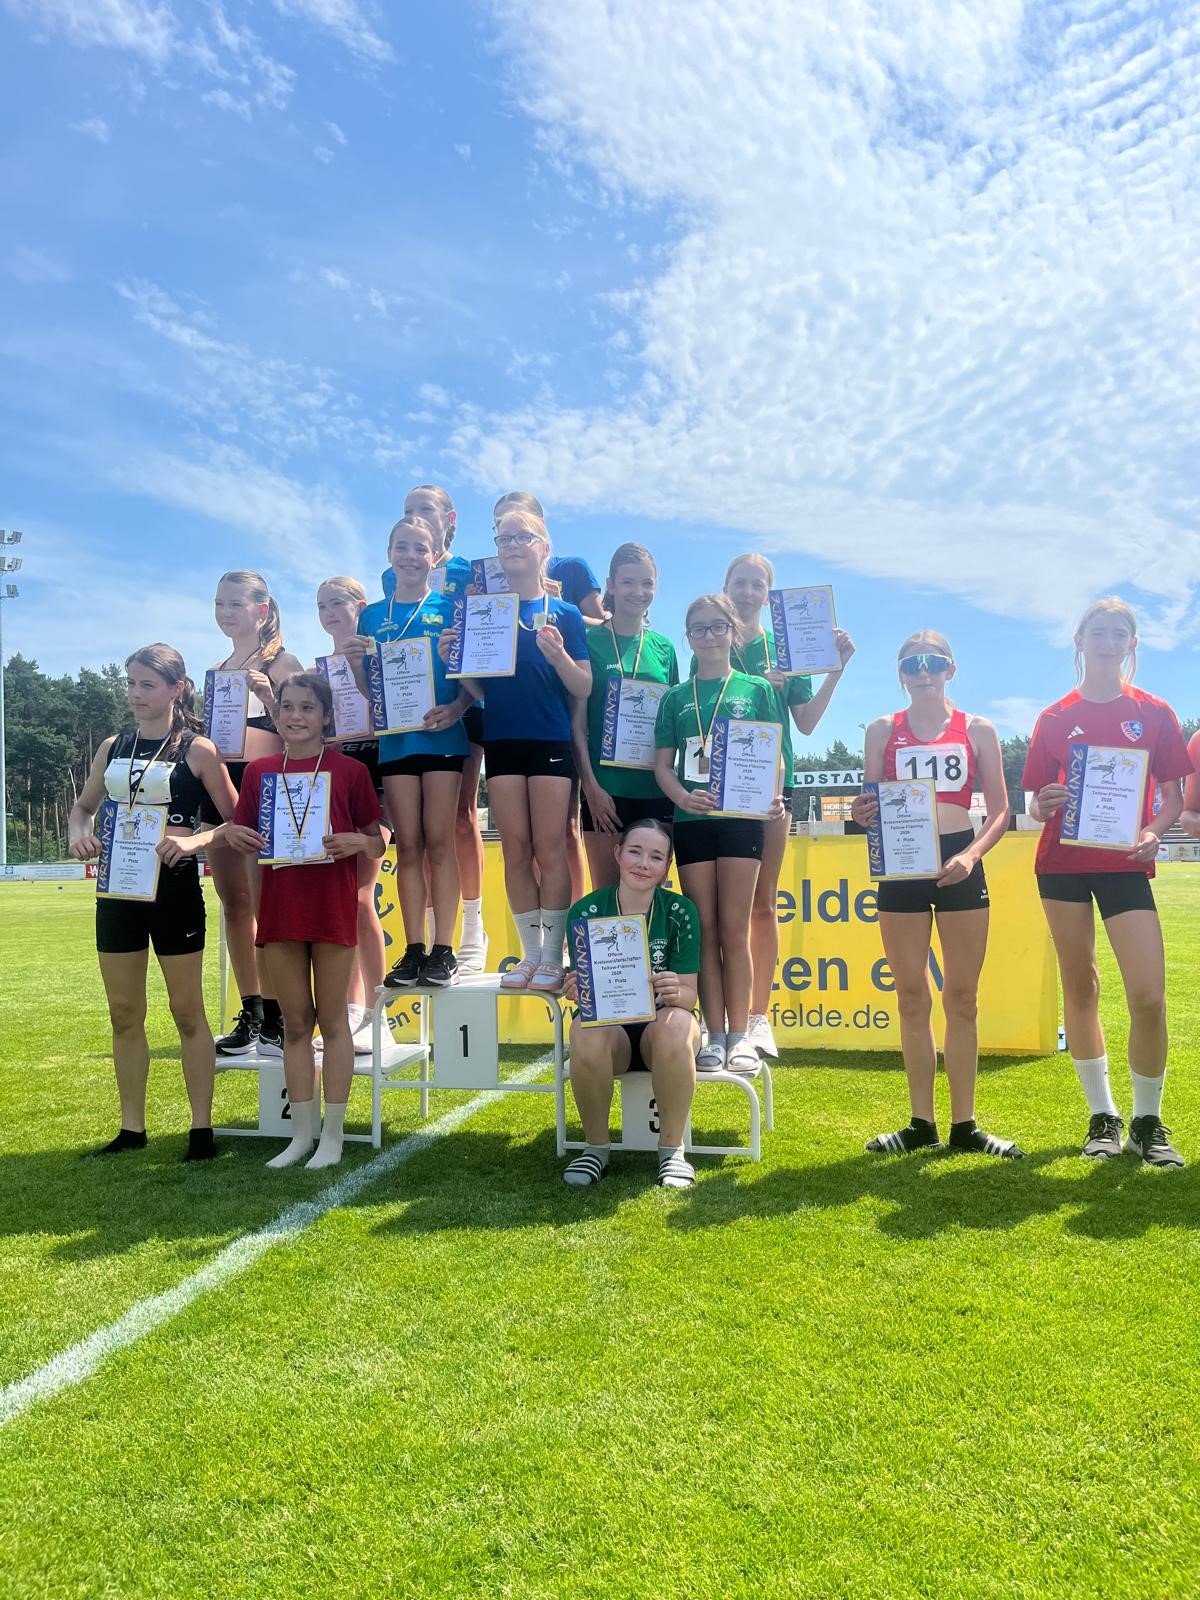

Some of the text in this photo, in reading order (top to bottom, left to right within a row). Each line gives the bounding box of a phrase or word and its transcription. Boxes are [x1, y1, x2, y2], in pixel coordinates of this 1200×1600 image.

[448, 599, 464, 671] URKUNDE
[369, 653, 384, 728] URKUND
[602, 680, 618, 758] URKUNDE
[905, 755, 961, 780] 118
[1064, 749, 1083, 836] URKUNDE
[98, 806, 115, 889] URKUNDE
[260, 777, 274, 856] URKUNDE
[574, 924, 593, 1018] URKUNDE
[459, 1025, 469, 1058] 1
[770, 1003, 890, 1029] felde.de
